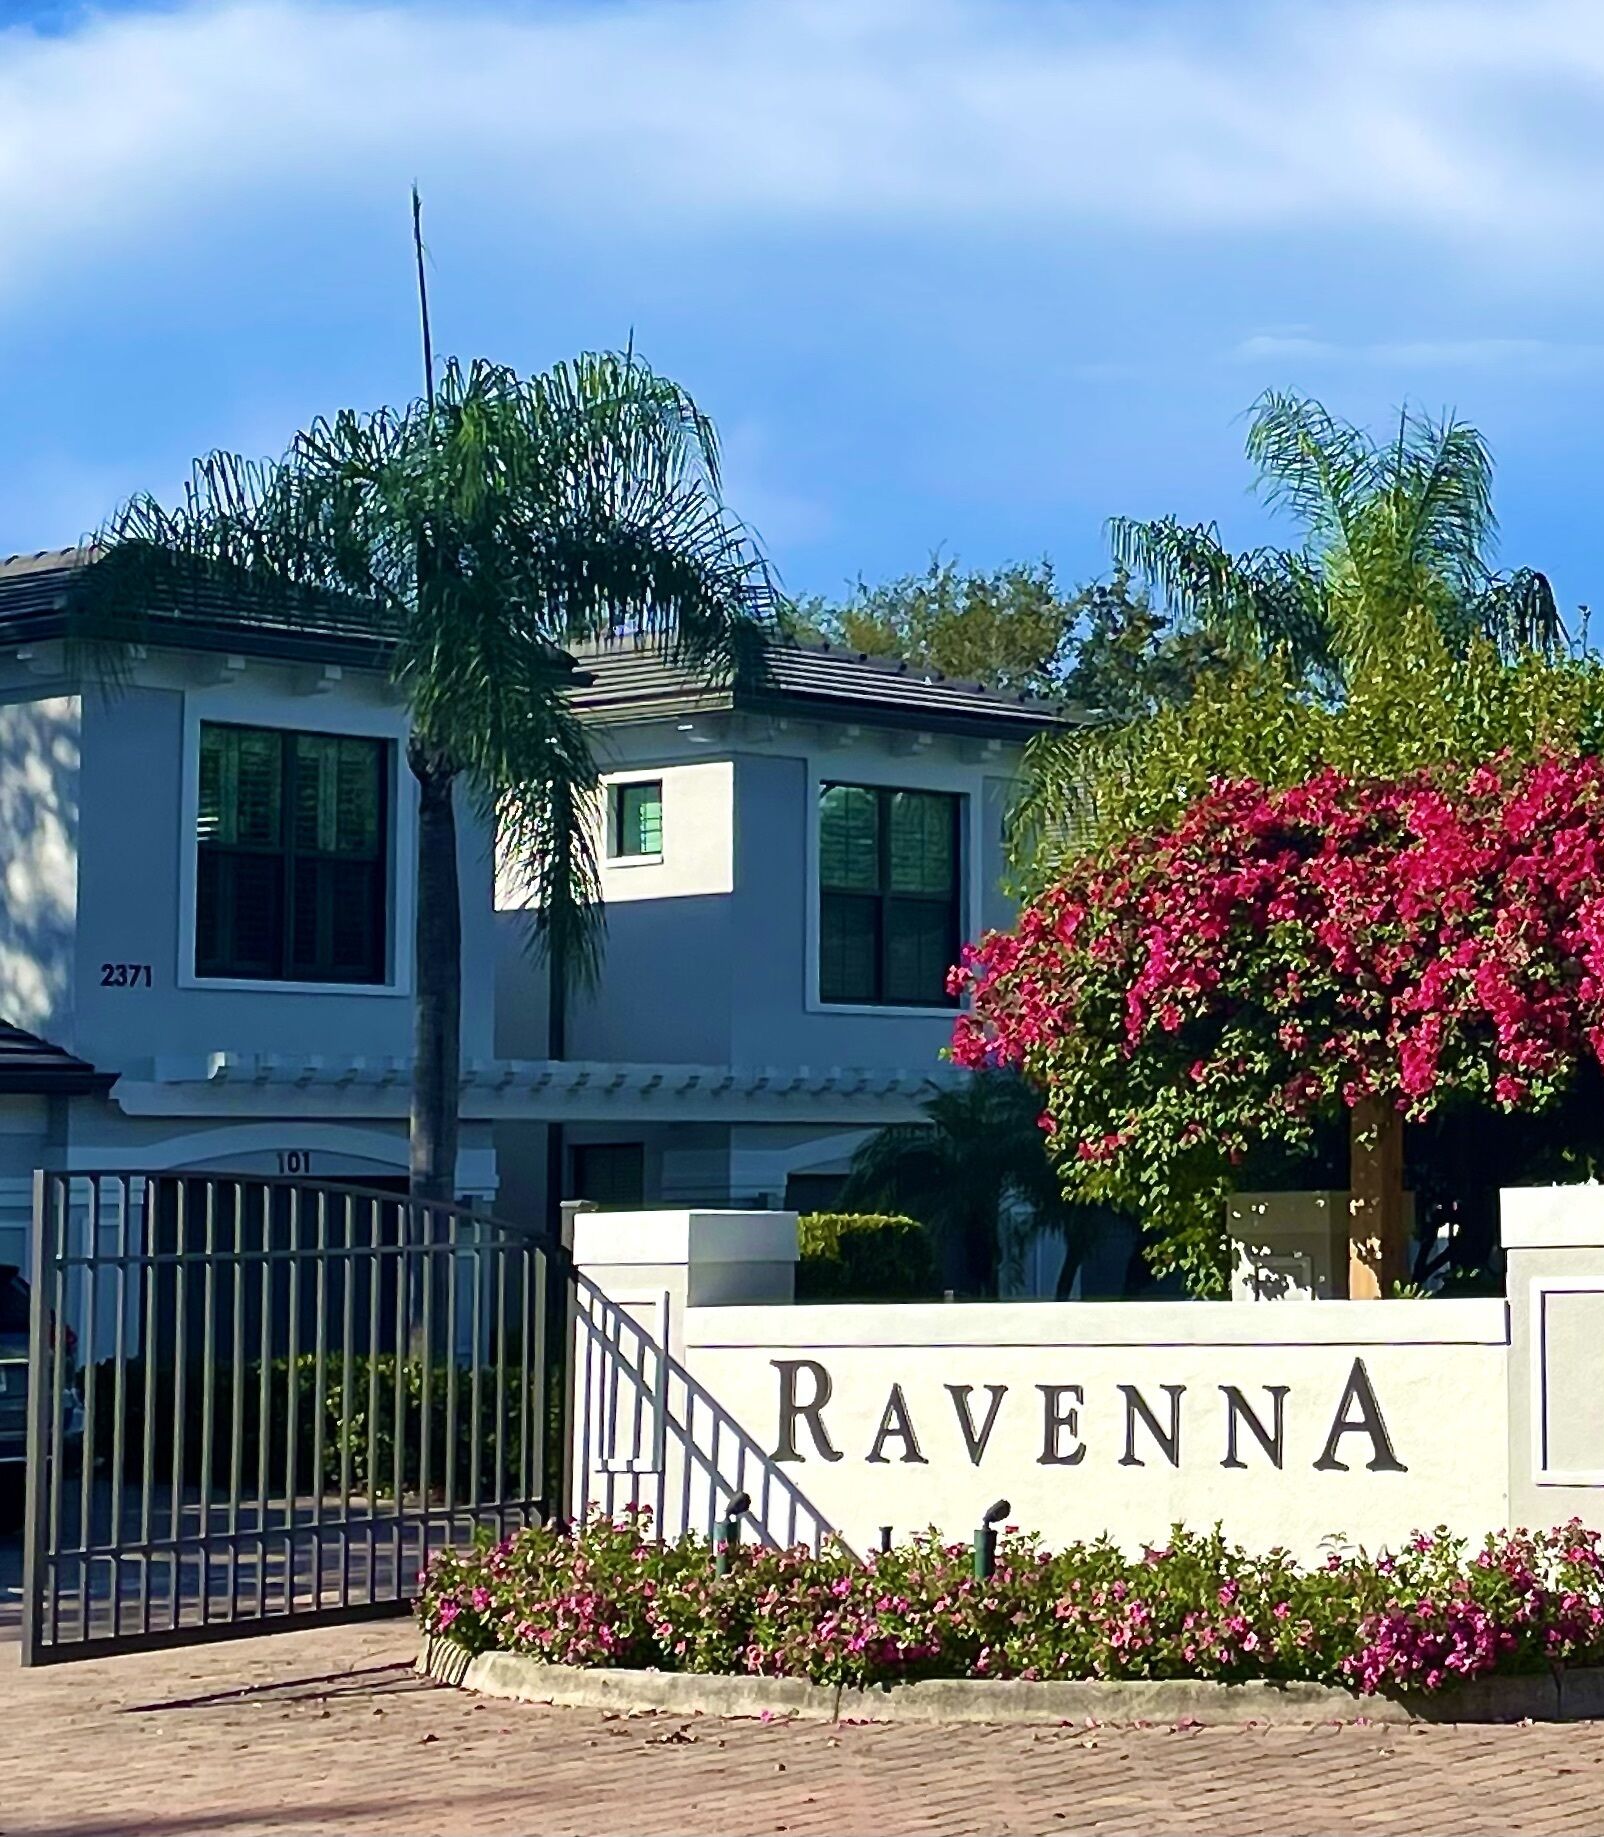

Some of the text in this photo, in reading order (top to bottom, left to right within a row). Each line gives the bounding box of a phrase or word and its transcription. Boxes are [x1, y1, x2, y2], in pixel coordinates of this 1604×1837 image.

[100, 963, 152, 988] 2371
[277, 1151, 310, 1174] 101
[769, 1356, 1408, 1472] RAVENNA
